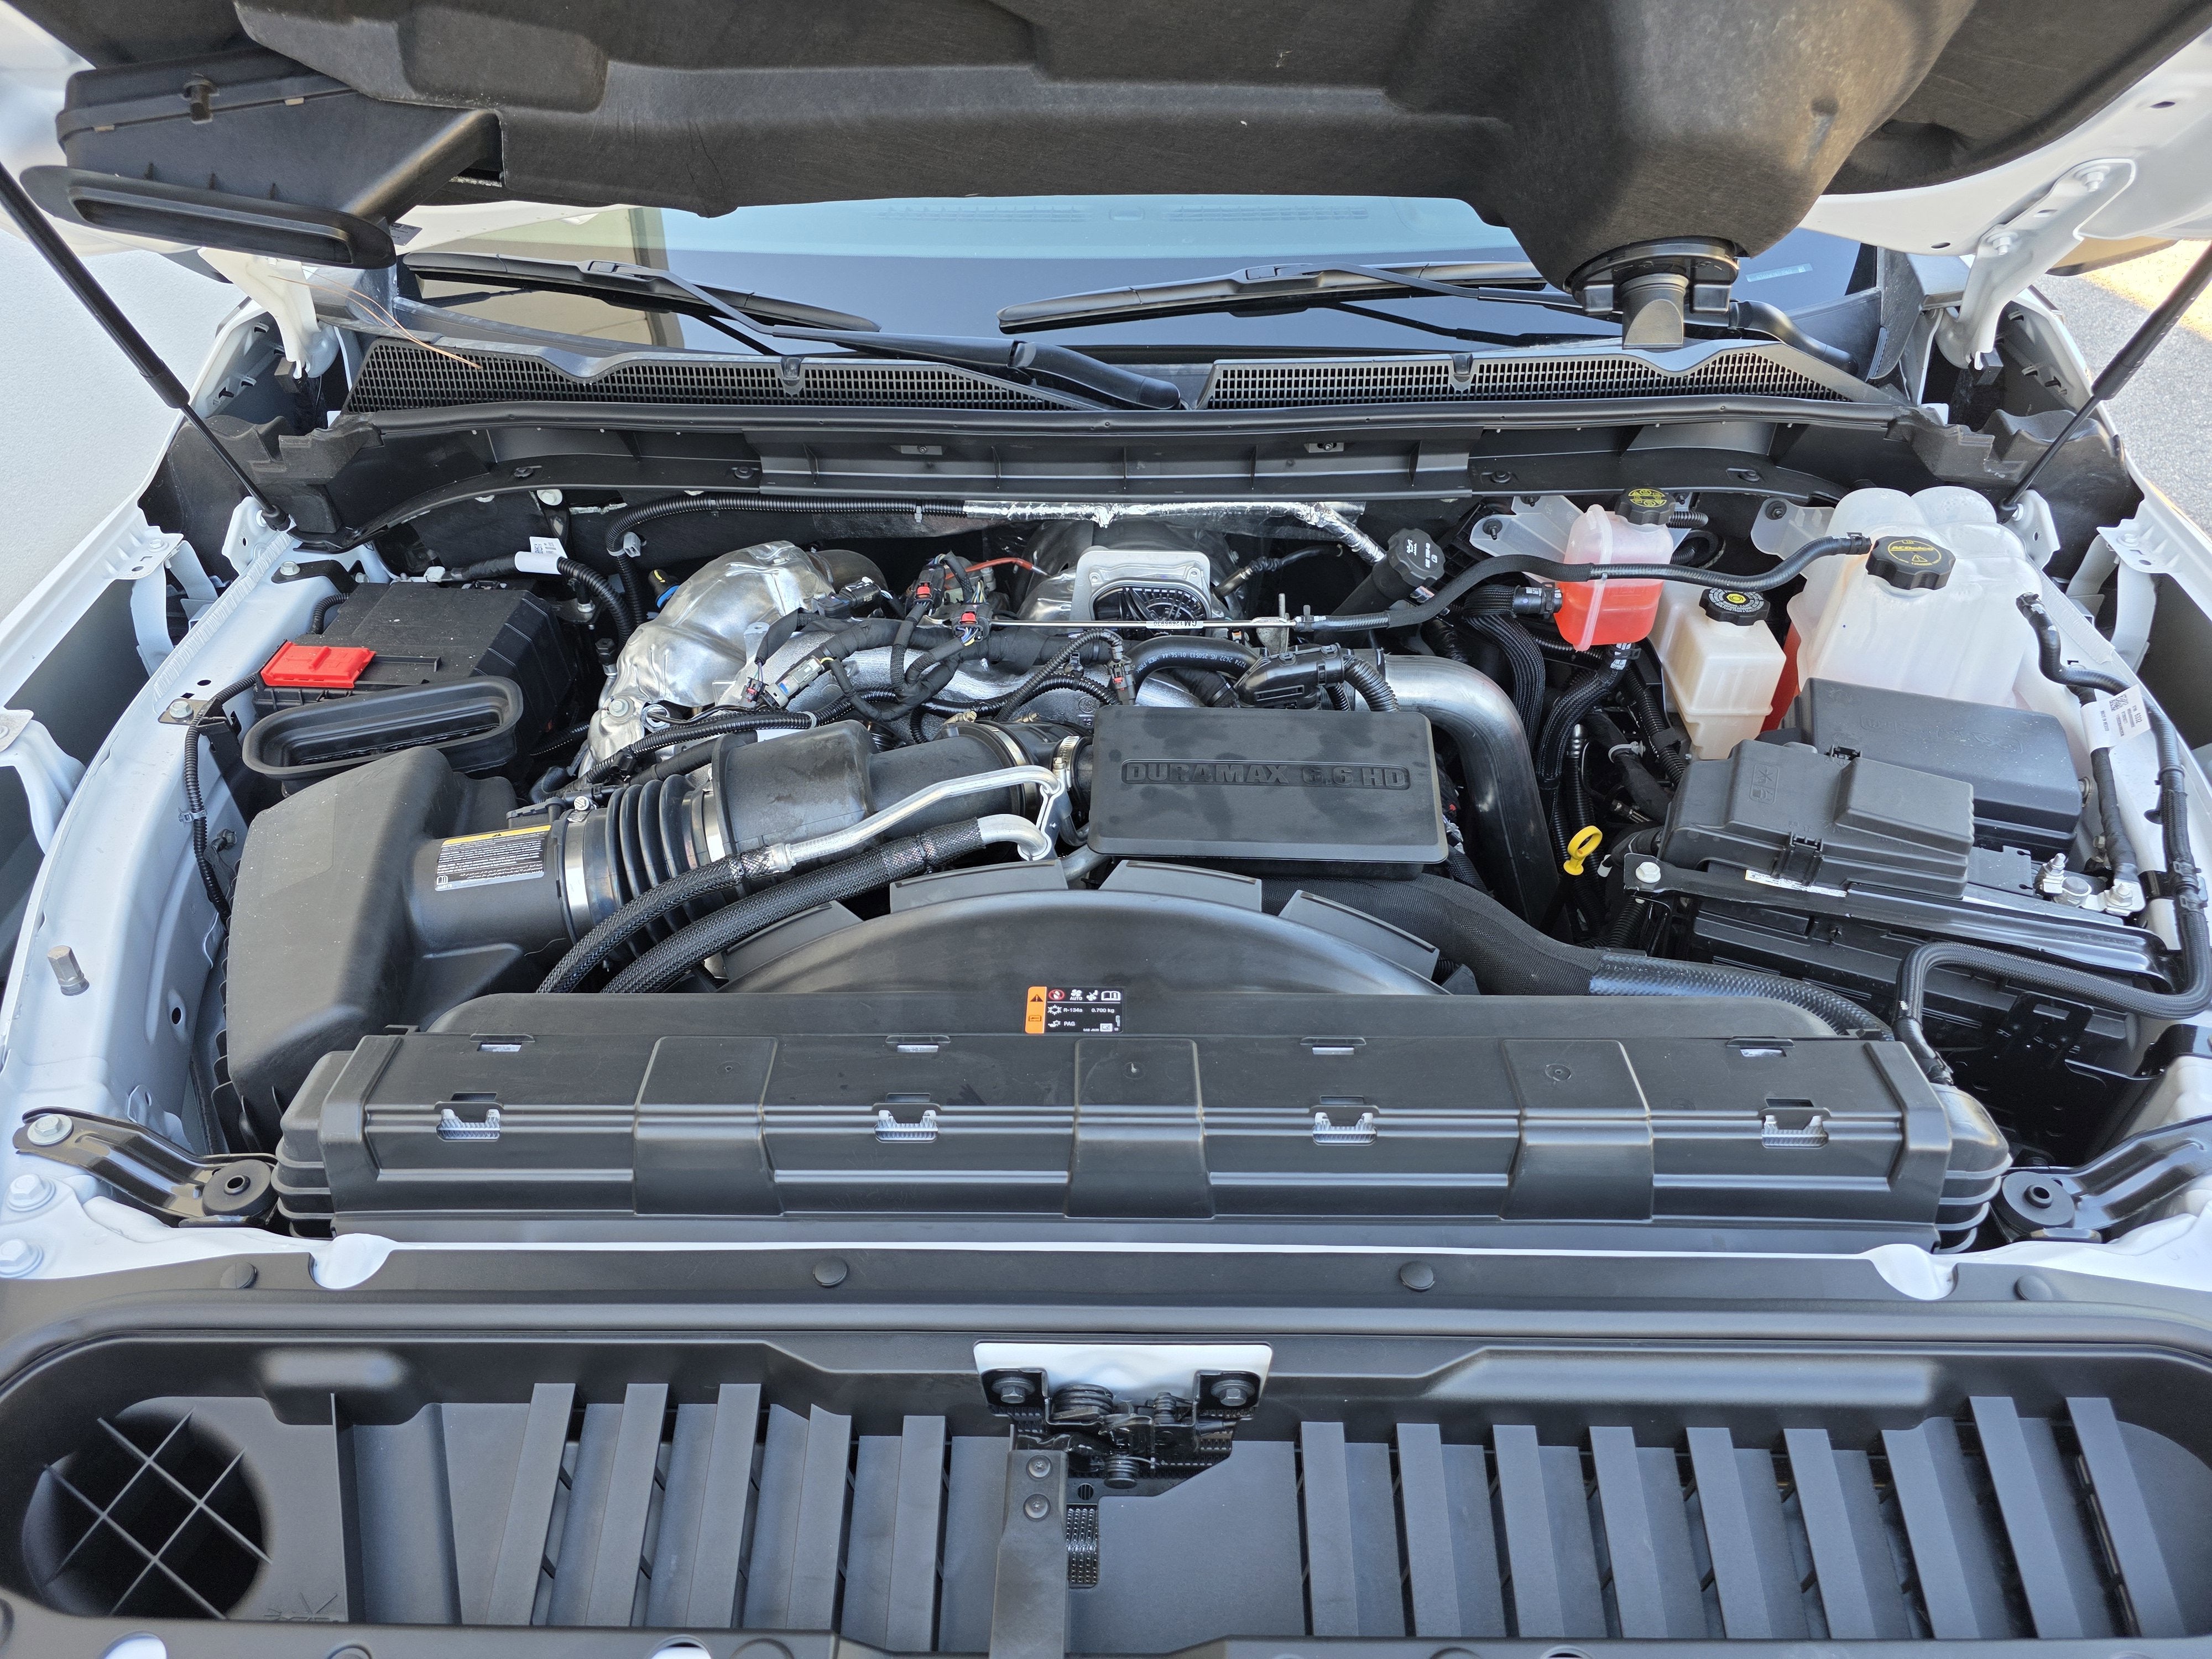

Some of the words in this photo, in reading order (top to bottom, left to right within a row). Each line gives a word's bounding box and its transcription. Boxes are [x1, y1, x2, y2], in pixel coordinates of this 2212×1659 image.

[1234, 659, 1246, 668] 1274
[1126, 763, 1290, 785] DURAMAX
[1302, 766, 1354, 786] 6.6
[1361, 768, 1407, 787] HD
